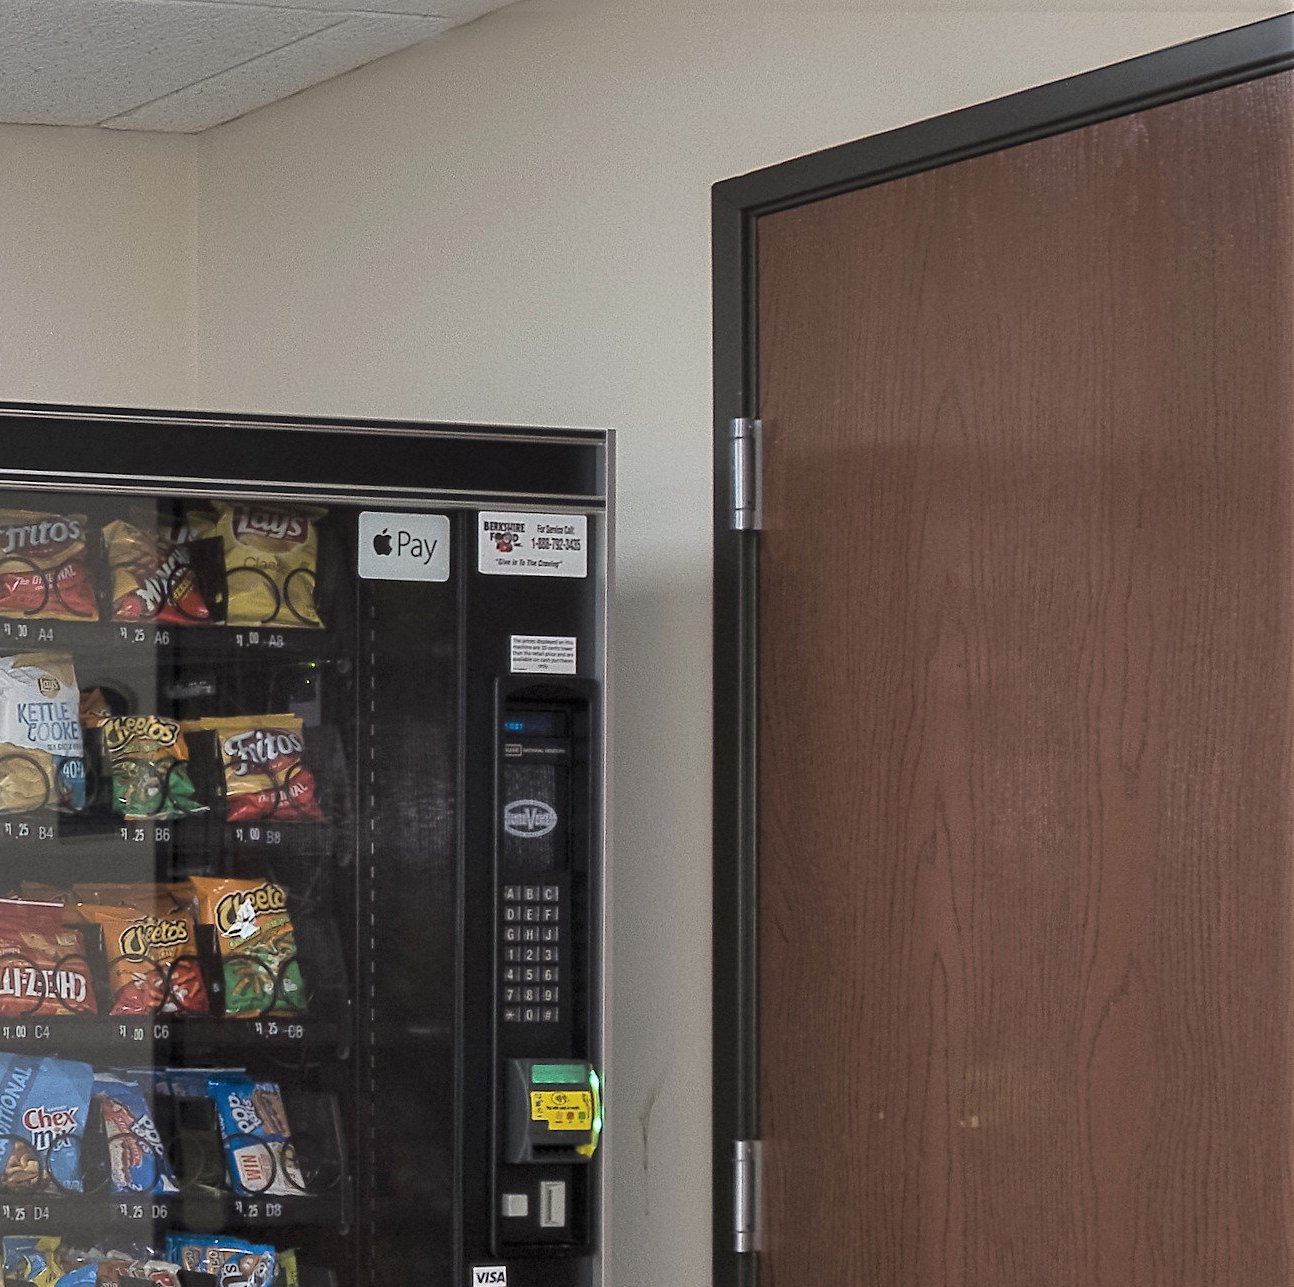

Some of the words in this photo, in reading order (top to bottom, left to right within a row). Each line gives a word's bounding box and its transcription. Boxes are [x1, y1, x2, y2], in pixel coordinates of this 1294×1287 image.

[484, 521, 525, 533] BERKSHIRE
[397, 531, 438, 564] Pay
[38, 628, 54, 640] A4
[155, 632, 169, 645] A6
[269, 635, 284, 648] A8
[17, 703, 70, 725] KETTLE
[224, 729, 303, 777] Fritos
[39, 827, 53, 839] B4
[155, 828, 170, 841] B6
[507, 889, 514, 899] A
[526, 889, 533, 899] B
[545, 889, 553, 899] C
[507, 910, 514, 920] D
[526, 910, 533, 920] E
[545, 910, 553, 920] F
[507, 929, 514, 940] G
[545, 929, 553, 940] J
[507, 950, 514, 960] 1
[526, 950, 533, 960] 2
[545, 950, 553, 960] 3
[507, 969, 514, 980] 4
[526, 969, 533, 980] 5
[545, 969, 553, 980] 6
[507, 990, 514, 1000] 7
[526, 990, 533, 1000] 8
[545, 990, 553, 1000] 9
[526, 1010, 533, 1020] 0
[35, 1025, 49, 1038] C4
[154, 1025, 169, 1038] C6
[22, 1106, 79, 1131] Chex
[241, 1155, 262, 1181] WIN
[34, 1207, 49, 1219] D4
[152, 1205, 167, 1218] D6
[266, 1204, 281, 1216] D8
[476, 1272, 505, 1284] VISA
